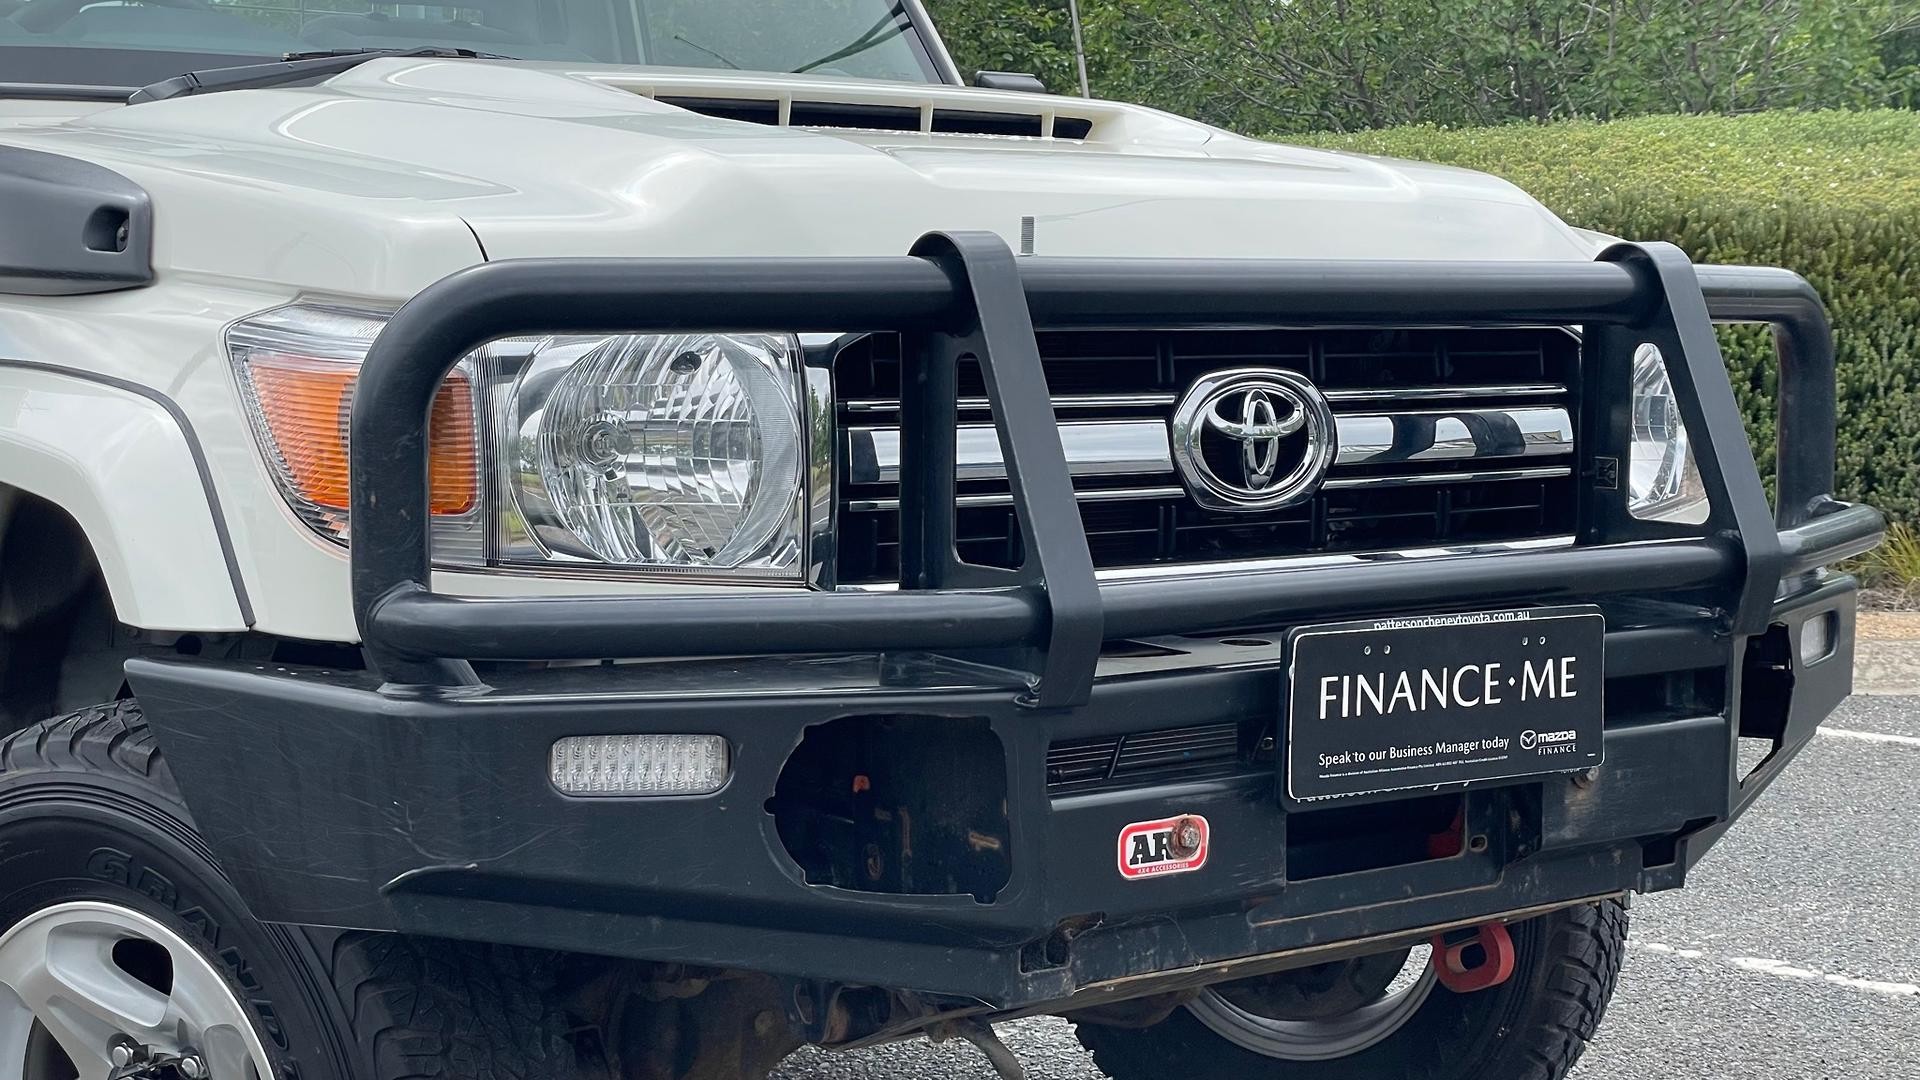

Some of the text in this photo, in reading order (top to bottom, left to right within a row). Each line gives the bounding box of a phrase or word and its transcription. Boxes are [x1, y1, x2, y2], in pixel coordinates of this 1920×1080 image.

[1538, 730, 1577, 743] mazda
[1319, 750, 1351, 768] Speak
[1354, 751, 1366, 762] to
[1369, 750, 1387, 761] our
[1389, 745, 1433, 759] Business
[1436, 741, 1479, 755] Manager
[1482, 736, 1510, 750] today
[1538, 744, 1577, 755] FINANCE
[1152, 862, 1190, 873] ACCESSORIES
